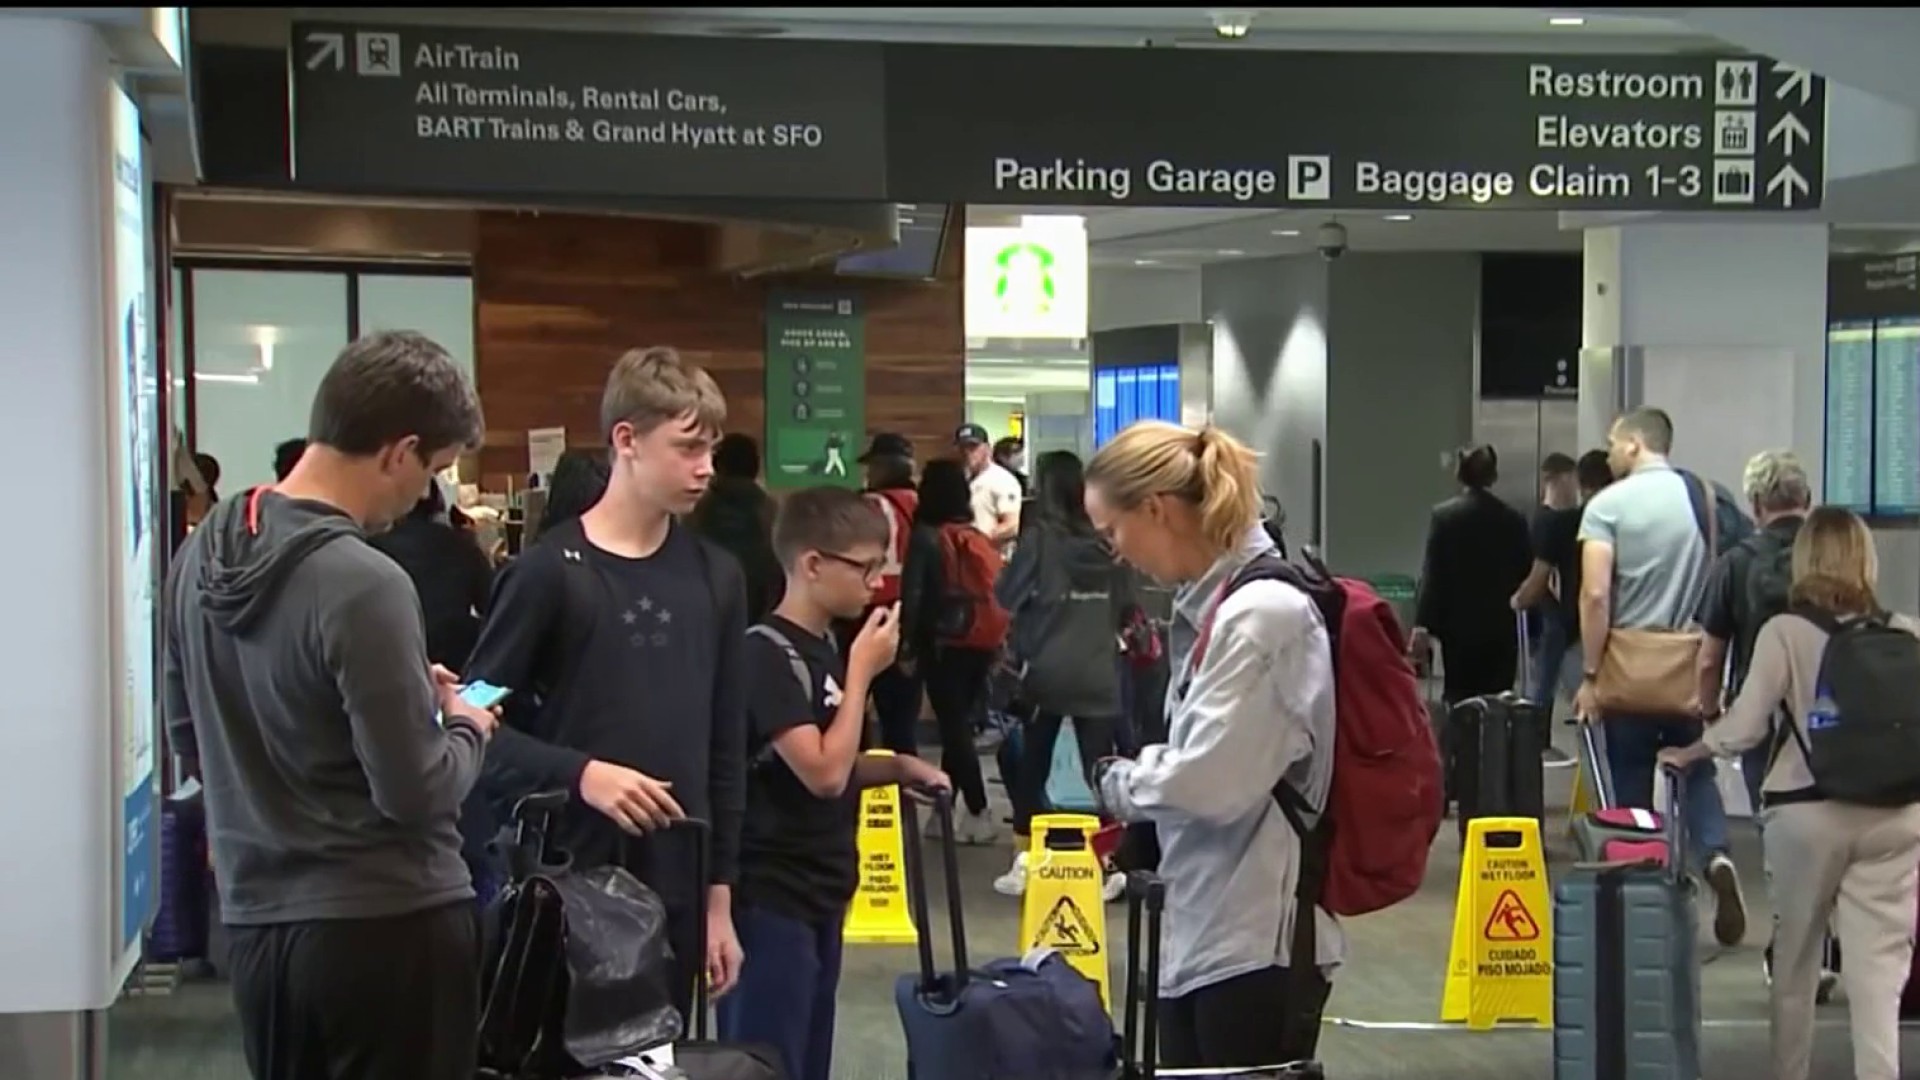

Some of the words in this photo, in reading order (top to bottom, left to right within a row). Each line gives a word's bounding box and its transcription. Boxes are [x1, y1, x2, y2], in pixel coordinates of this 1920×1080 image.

[414, 43, 519, 71] AirTrain
[1528, 64, 1703, 98] Restroom
[415, 82, 448, 104] All
[451, 83, 576, 110] Terminals,
[582, 86, 659, 110] Rental
[666, 89, 728, 114] Cars,
[416, 116, 485, 138] BART
[487, 117, 560, 141] Trains
[565, 119, 585, 141] &
[592, 119, 666, 143] Grand
[671, 121, 737, 149] Hyatt
[742, 125, 766, 146] at
[772, 124, 822, 147] SFO
[1537, 115, 1702, 148] Elevators
[995, 158, 1130, 199] Parking
[1147, 160, 1276, 200] Garage
[1355, 162, 1514, 203] Baggage
[1529, 164, 1630, 197] Claim
[1645, 165, 1702, 197] 1-3
[1039, 866, 1094, 880] CAUTION
[1481, 871, 1501, 881] WET
[1503, 870, 1535, 881] FLOOR
[1487, 859, 1529, 869] CAUTION
[1478, 964, 1503, 976] PISO
[1505, 963, 1551, 976] MOJADO
[1488, 949, 1536, 961] CUIDADO
